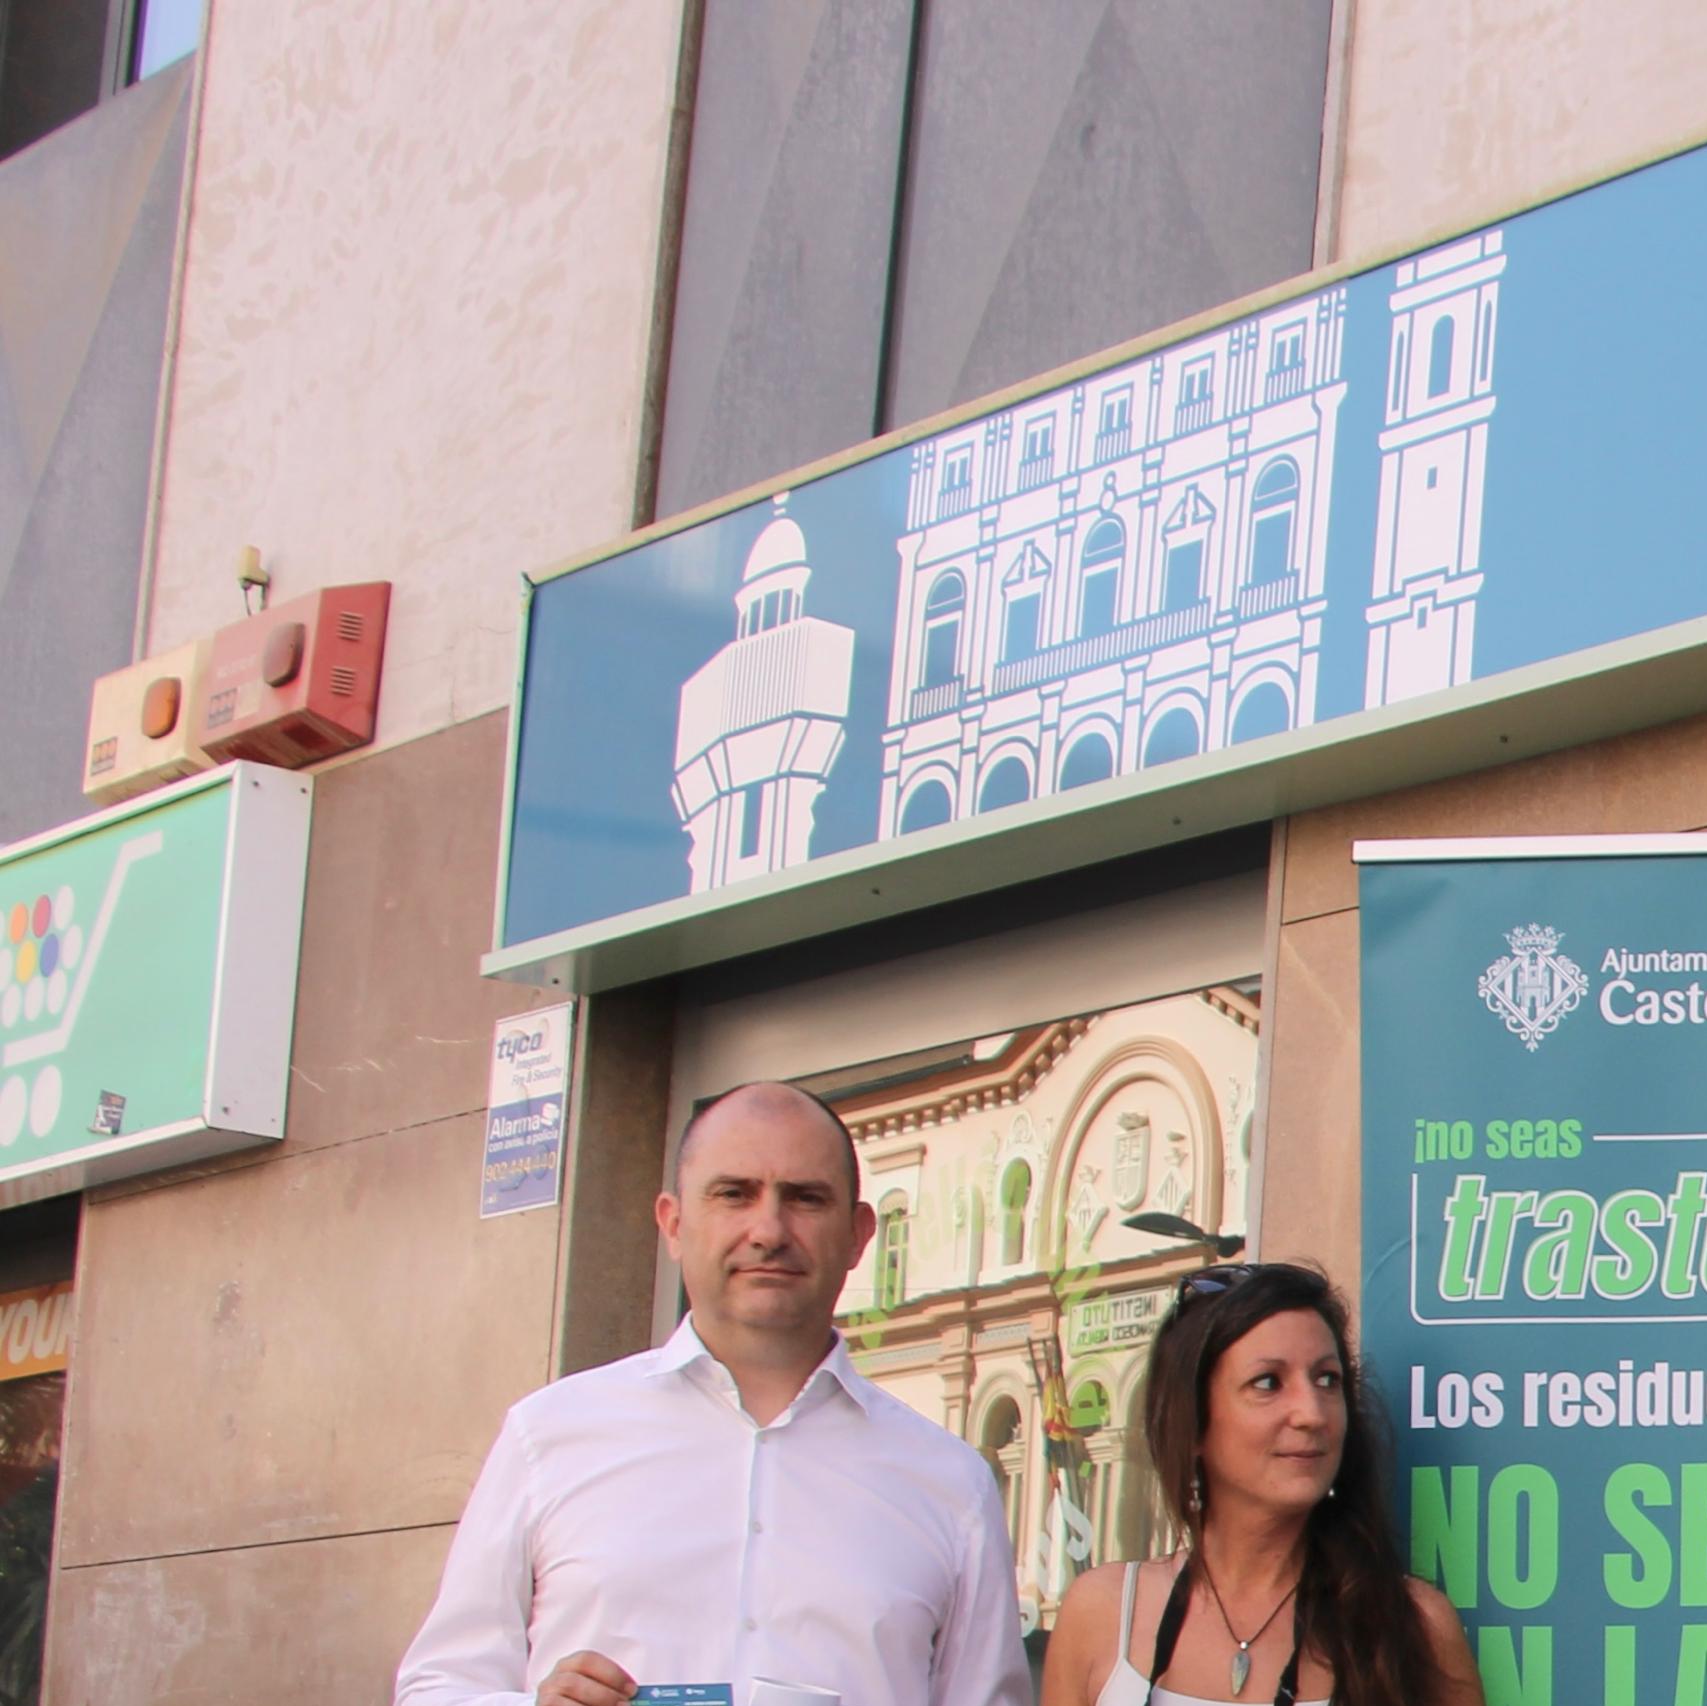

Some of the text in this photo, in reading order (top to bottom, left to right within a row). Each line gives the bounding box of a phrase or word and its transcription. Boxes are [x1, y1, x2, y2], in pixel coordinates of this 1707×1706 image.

[496, 1032, 542, 1065] tyco
[490, 1112, 542, 1140] Alarma
[1414, 1118, 1583, 1164] ¡no seas
[1411, 1365, 1504, 1429] Los
[1411, 1463, 1560, 1610] NO
